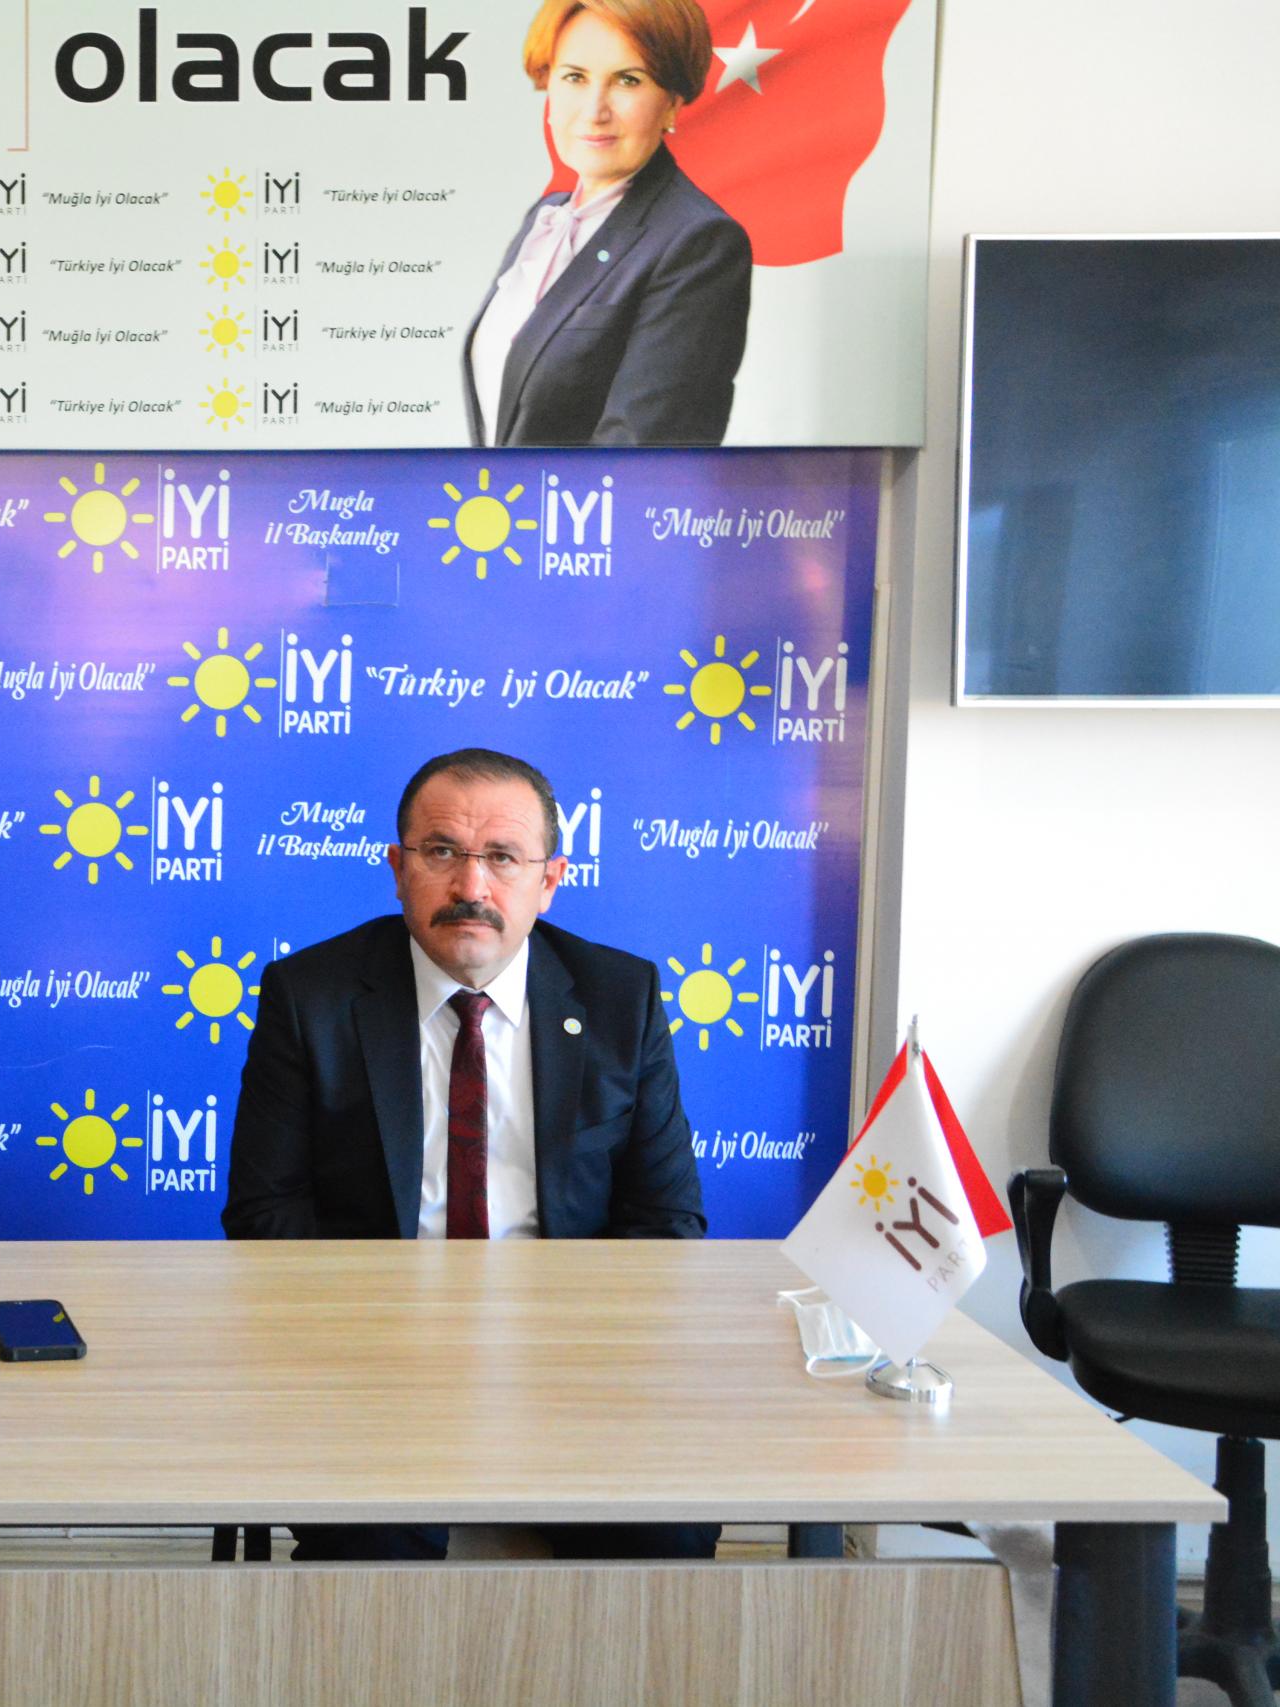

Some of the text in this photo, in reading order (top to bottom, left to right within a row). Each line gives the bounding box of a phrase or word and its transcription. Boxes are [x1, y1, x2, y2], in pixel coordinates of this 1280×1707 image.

[55, 7, 470, 103] olacak
[266, 172, 299, 203] İYİ
[265, 242, 298, 273] İYİ
[264, 310, 297, 341] İYİ
[264, 383, 297, 414] İYİ
[161, 469, 229, 540] İYİ
[546, 475, 613, 545] İYİ
[738, 509, 763, 547] İyi
[162, 541, 228, 569] PARTİ
[545, 546, 611, 576] PARTİ
[49, 661, 76, 700] İyi
[286, 633, 352, 703] İYİ
[366, 664, 649, 708] “Türkiye İyi Olacak”
[781, 642, 848, 711] İYİ
[285, 706, 350, 734] PARTİ
[779, 715, 845, 742] PARTİ
[157, 781, 223, 850] İYİ
[555, 788, 602, 857] Yİ
[724, 820, 750, 858] İyi
[156, 853, 222, 880] PARTİ
[46, 970, 71, 1008] İyi
[768, 949, 834, 1017] İYİ
[766, 1018, 831, 1047] PARTİ
[152, 1094, 217, 1162] İYİ
[711, 1130, 738, 1168] İyi
[151, 1164, 215, 1191] PARTİ
